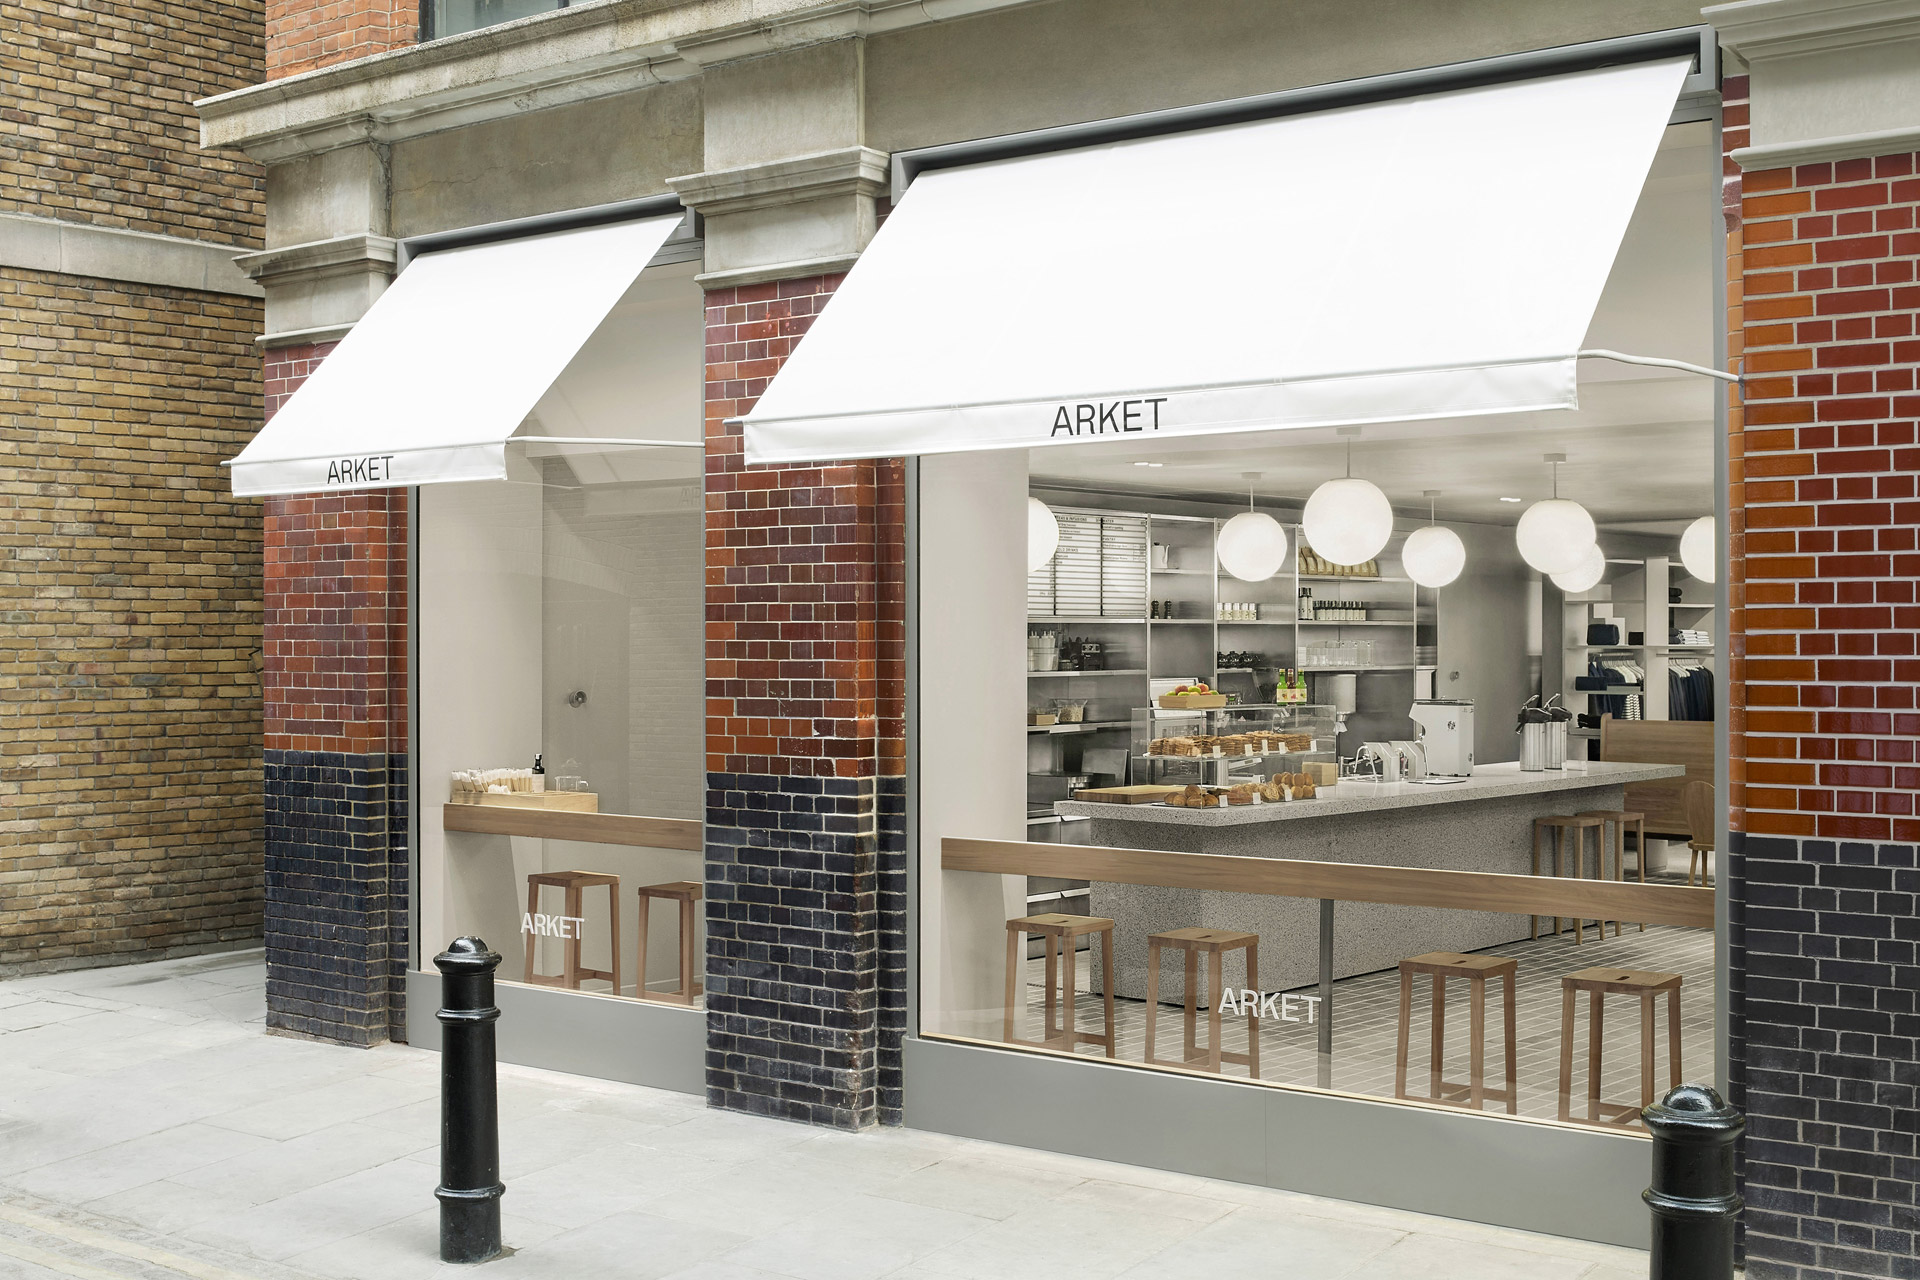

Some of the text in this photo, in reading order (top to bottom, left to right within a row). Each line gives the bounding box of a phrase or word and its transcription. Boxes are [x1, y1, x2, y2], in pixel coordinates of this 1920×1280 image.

[1050, 397, 1168, 437] ARKET
[327, 455, 394, 484] ARKET
[520, 912, 585, 940] ARKET
[1218, 987, 1322, 1024] ARKET
